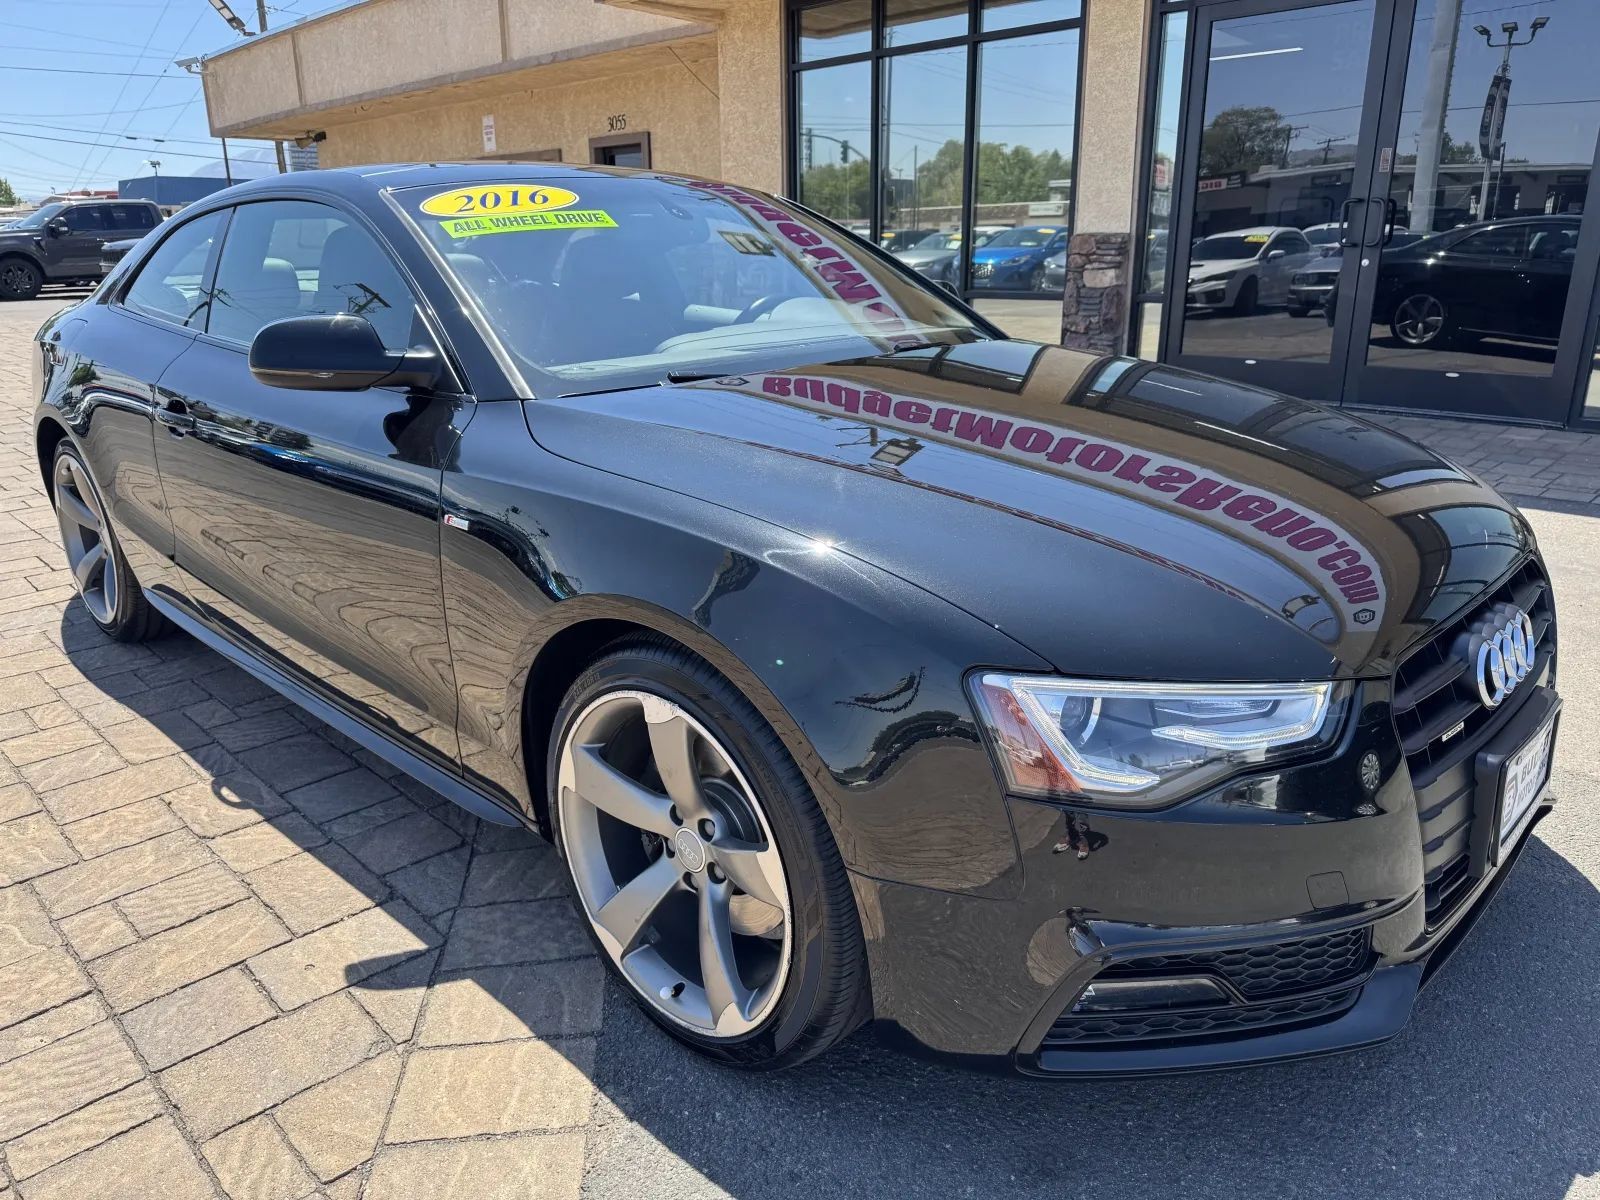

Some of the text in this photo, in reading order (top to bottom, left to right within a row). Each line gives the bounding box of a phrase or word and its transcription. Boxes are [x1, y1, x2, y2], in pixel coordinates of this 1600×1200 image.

[607, 114, 627, 132] 3055
[454, 188, 549, 213] 2016
[453, 211, 606, 234] ALL WHEEL DRIVE
